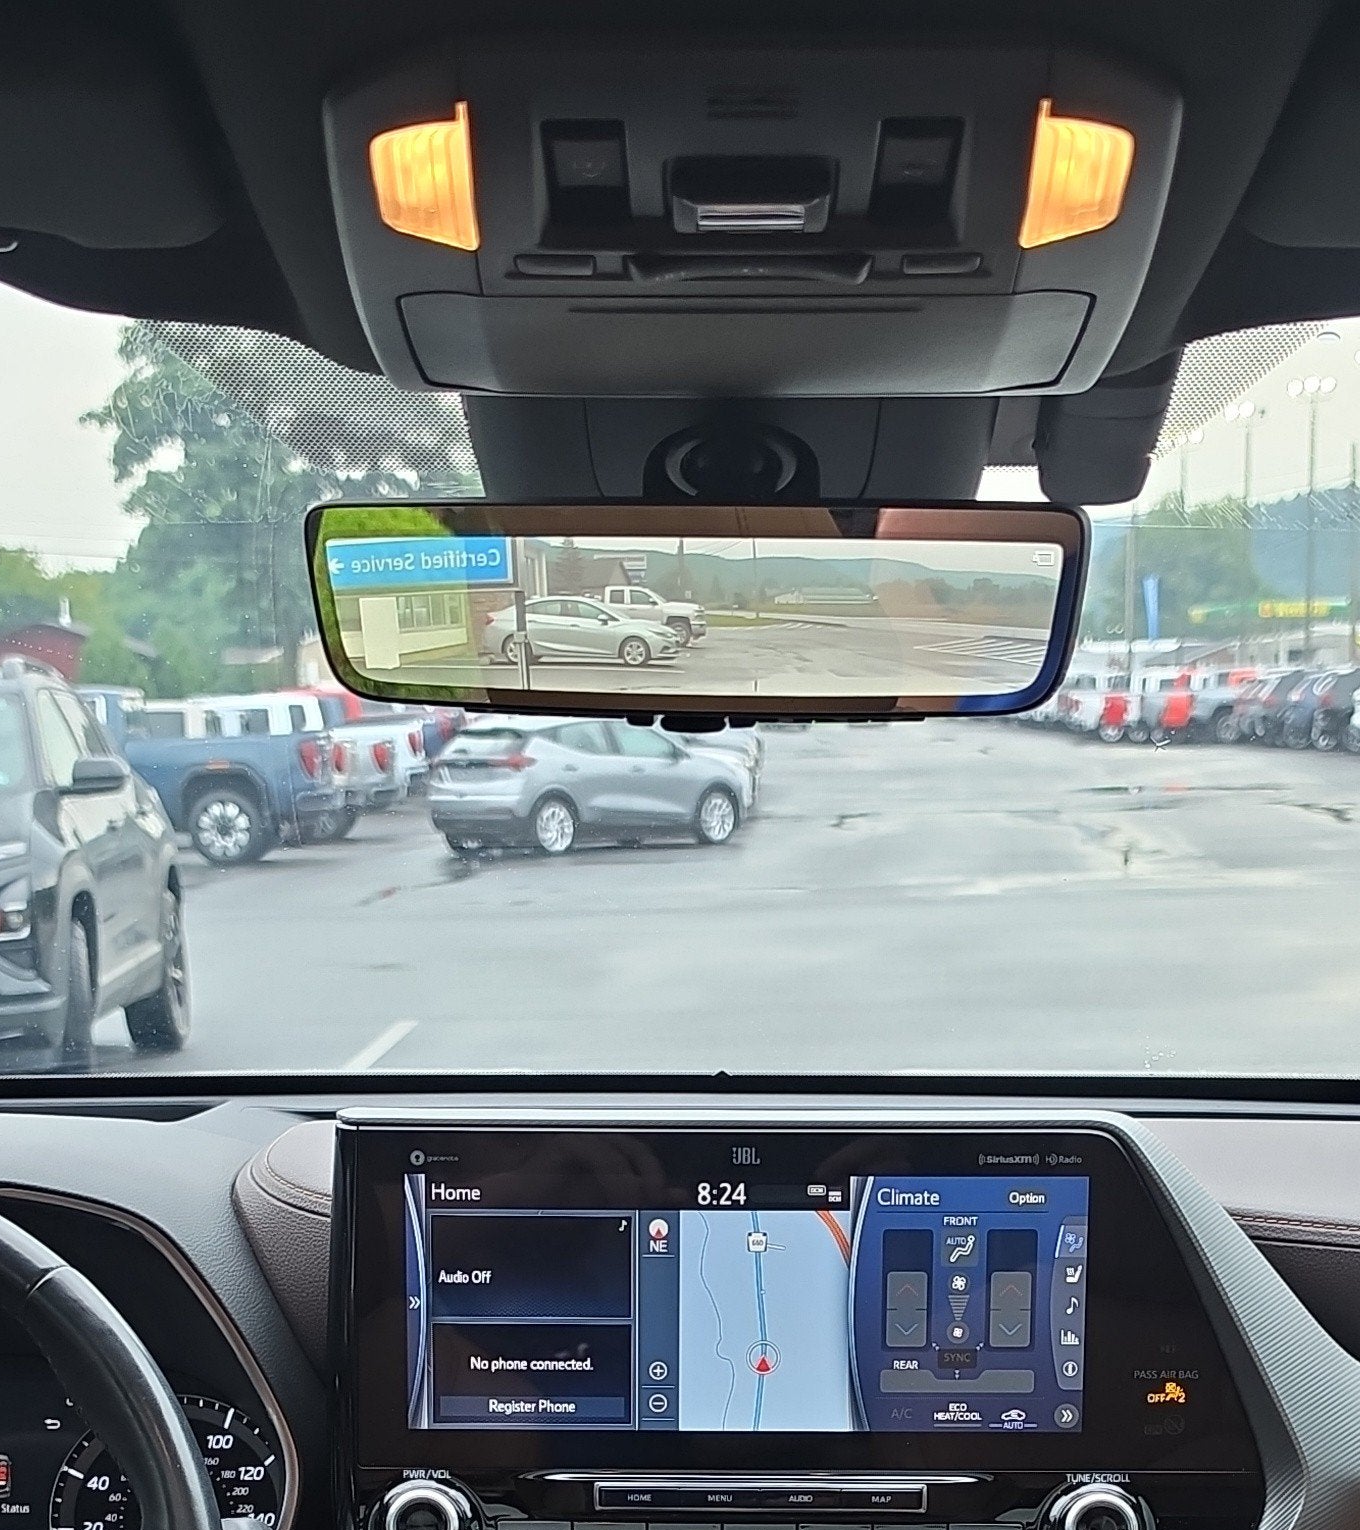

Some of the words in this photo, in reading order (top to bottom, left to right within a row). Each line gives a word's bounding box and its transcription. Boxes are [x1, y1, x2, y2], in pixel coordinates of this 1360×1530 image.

[733, 1147, 761, 1166] JBL
[1058, 1155, 1083, 1164] Radio
[431, 1182, 481, 1201] Home
[697, 1182, 747, 1206] 8:24
[877, 1188, 940, 1206] Climate
[1009, 1192, 1045, 1206] Option
[943, 1216, 978, 1226] FRONT
[649, 1240, 668, 1253] NE
[946, 1236, 967, 1246] AUTO
[438, 1270, 469, 1284] Audio
[471, 1270, 492, 1284] Off
[943, 1352, 971, 1363] SYNC
[470, 1356, 488, 1370] No
[491, 1356, 528, 1374] phone
[530, 1356, 594, 1371] connected.
[893, 1359, 918, 1370] REAR
[1134, 1370, 1158, 1379] PASS
[1160, 1370, 1177, 1379] AIR
[1178, 1370, 1199, 1379] BAG
[1147, 1393, 1166, 1403] OFF
[488, 1399, 537, 1416] Register
[538, 1399, 576, 1414] Phone
[948, 1402, 967, 1412] ECO
[891, 1407, 913, 1420] A/C
[934, 1411, 982, 1422] HEAT/COOL
[1003, 1421, 1024, 1430] AUTO
[206, 1434, 233, 1450] 100
[220, 1470, 237, 1479] 180
[238, 1466, 265, 1481] 120
[403, 1468, 452, 1480] PWR/VOL
[1066, 1473, 1131, 1484] TUNE/SCROLL
[86, 1476, 110, 1491] 40
[108, 1492, 122, 1502] 60
[232, 1487, 249, 1496] 200
[627, 1494, 652, 1502] HOME
[707, 1494, 733, 1503] MENU
[788, 1494, 813, 1503] AUDIO
[871, 1495, 892, 1504] MAP
[1, 1503, 30, 1514] Status
[236, 1504, 254, 1513] 220
[104, 1513, 118, 1522] 40
